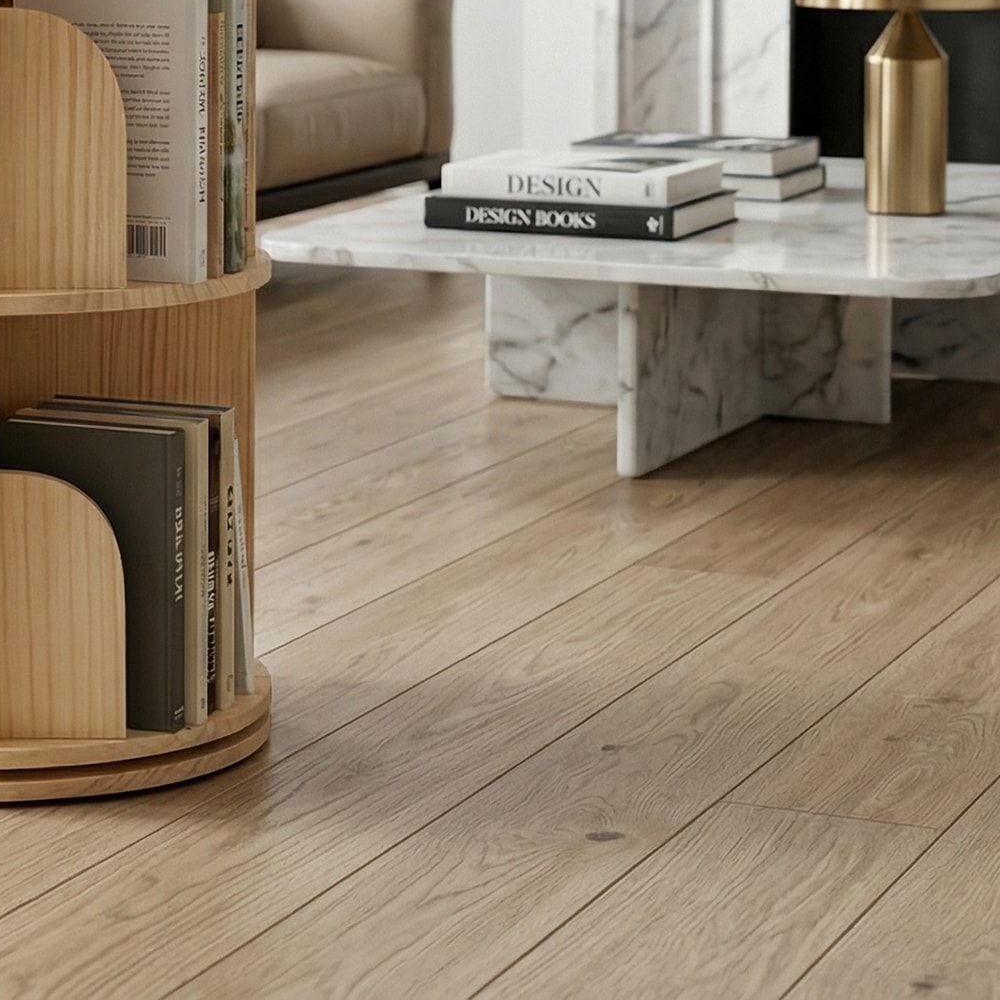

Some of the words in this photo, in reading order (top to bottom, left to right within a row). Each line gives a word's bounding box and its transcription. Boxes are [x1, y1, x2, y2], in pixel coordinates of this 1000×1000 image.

[507, 174, 602, 198] DESIGN
[465, 206, 531, 227] DESIGN
[535, 212, 596, 230] BOOKS
